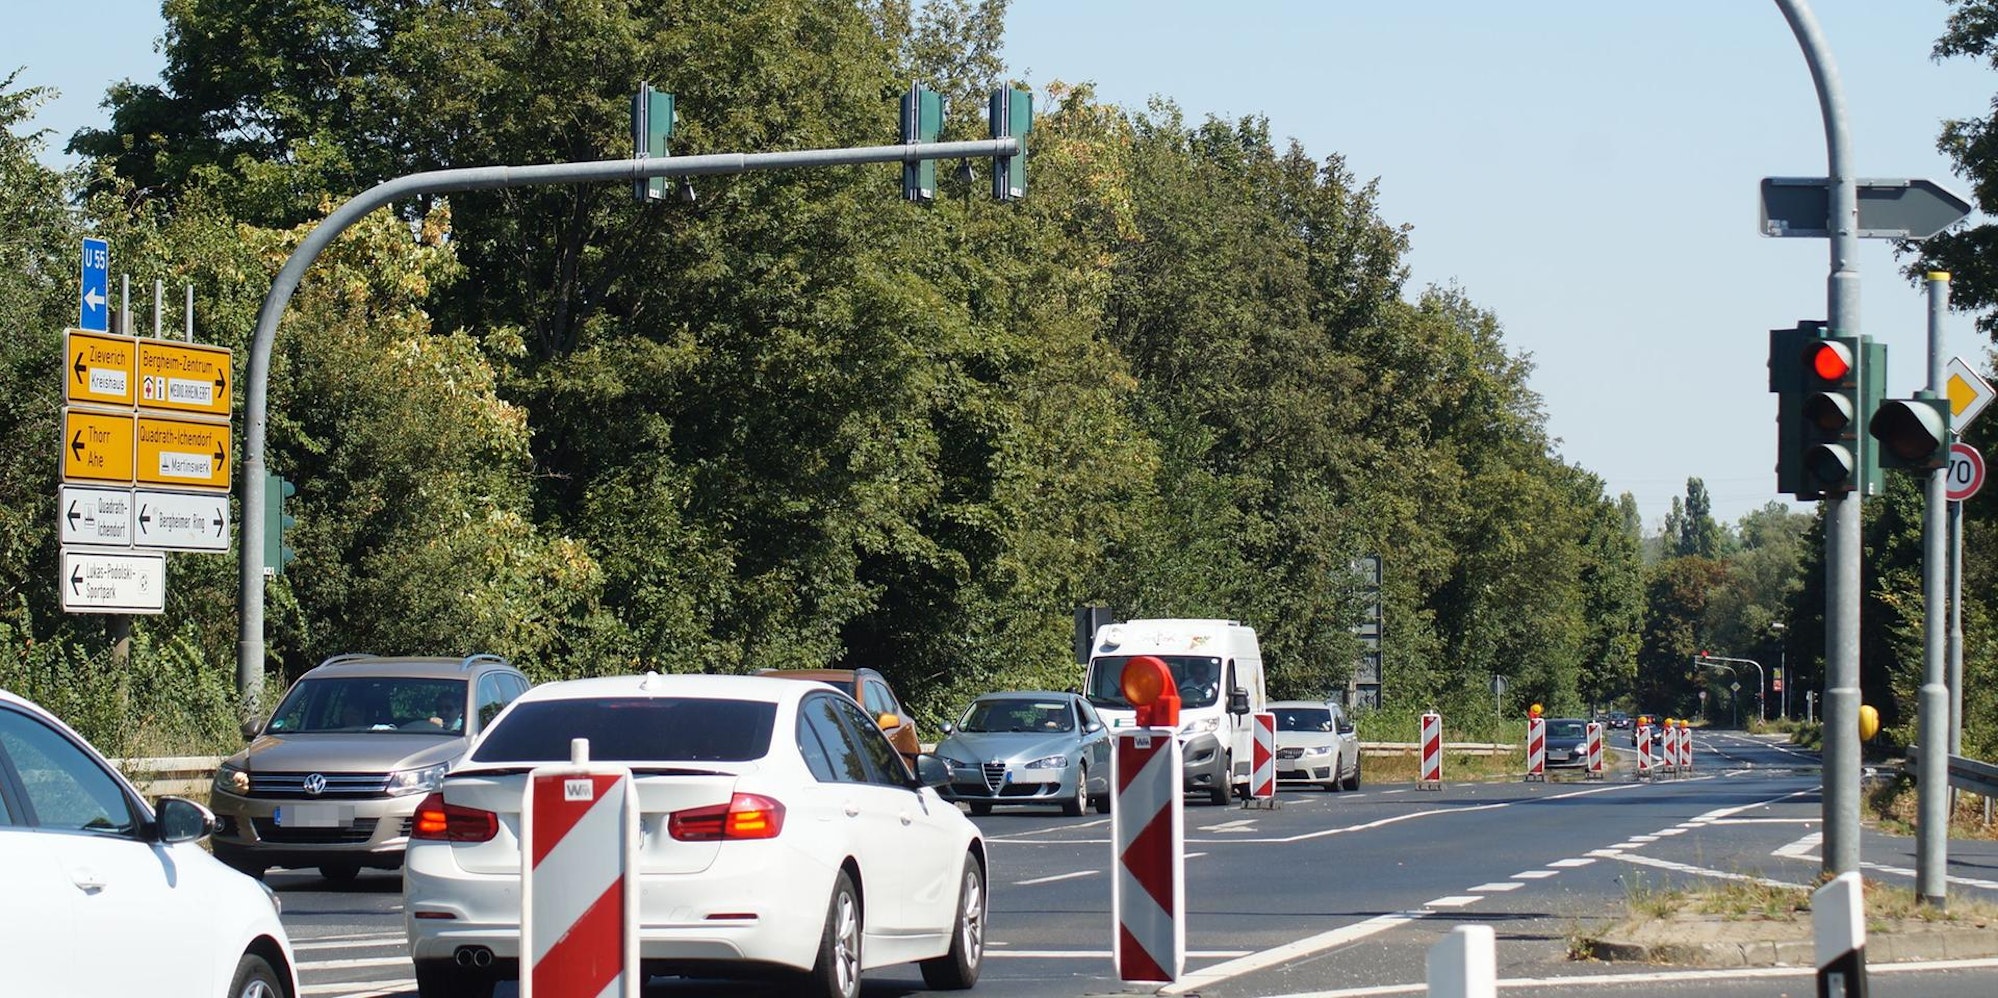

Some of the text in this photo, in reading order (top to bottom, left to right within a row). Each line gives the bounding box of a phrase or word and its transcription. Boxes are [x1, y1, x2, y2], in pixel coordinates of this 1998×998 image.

[85, 249, 105, 270] U 55
[89, 345, 125, 366] Zieverich
[143, 350, 213, 374] Bergheim-Zentrum
[91, 373, 125, 391] Kreishaus
[89, 425, 110, 444] Thorr
[139, 425, 212, 447] Quadrath-Ichendorf
[88, 451, 104, 468] Ahe
[171, 457, 210, 474] Martinswerk
[98, 497, 128, 515] Quadrath-
[98, 520, 126, 538] Ichendorf
[159, 511, 205, 534] Bergheimer Ring
[86, 561, 136, 580] Lukas-Podolski-
[86, 582, 117, 604] Sportpark
